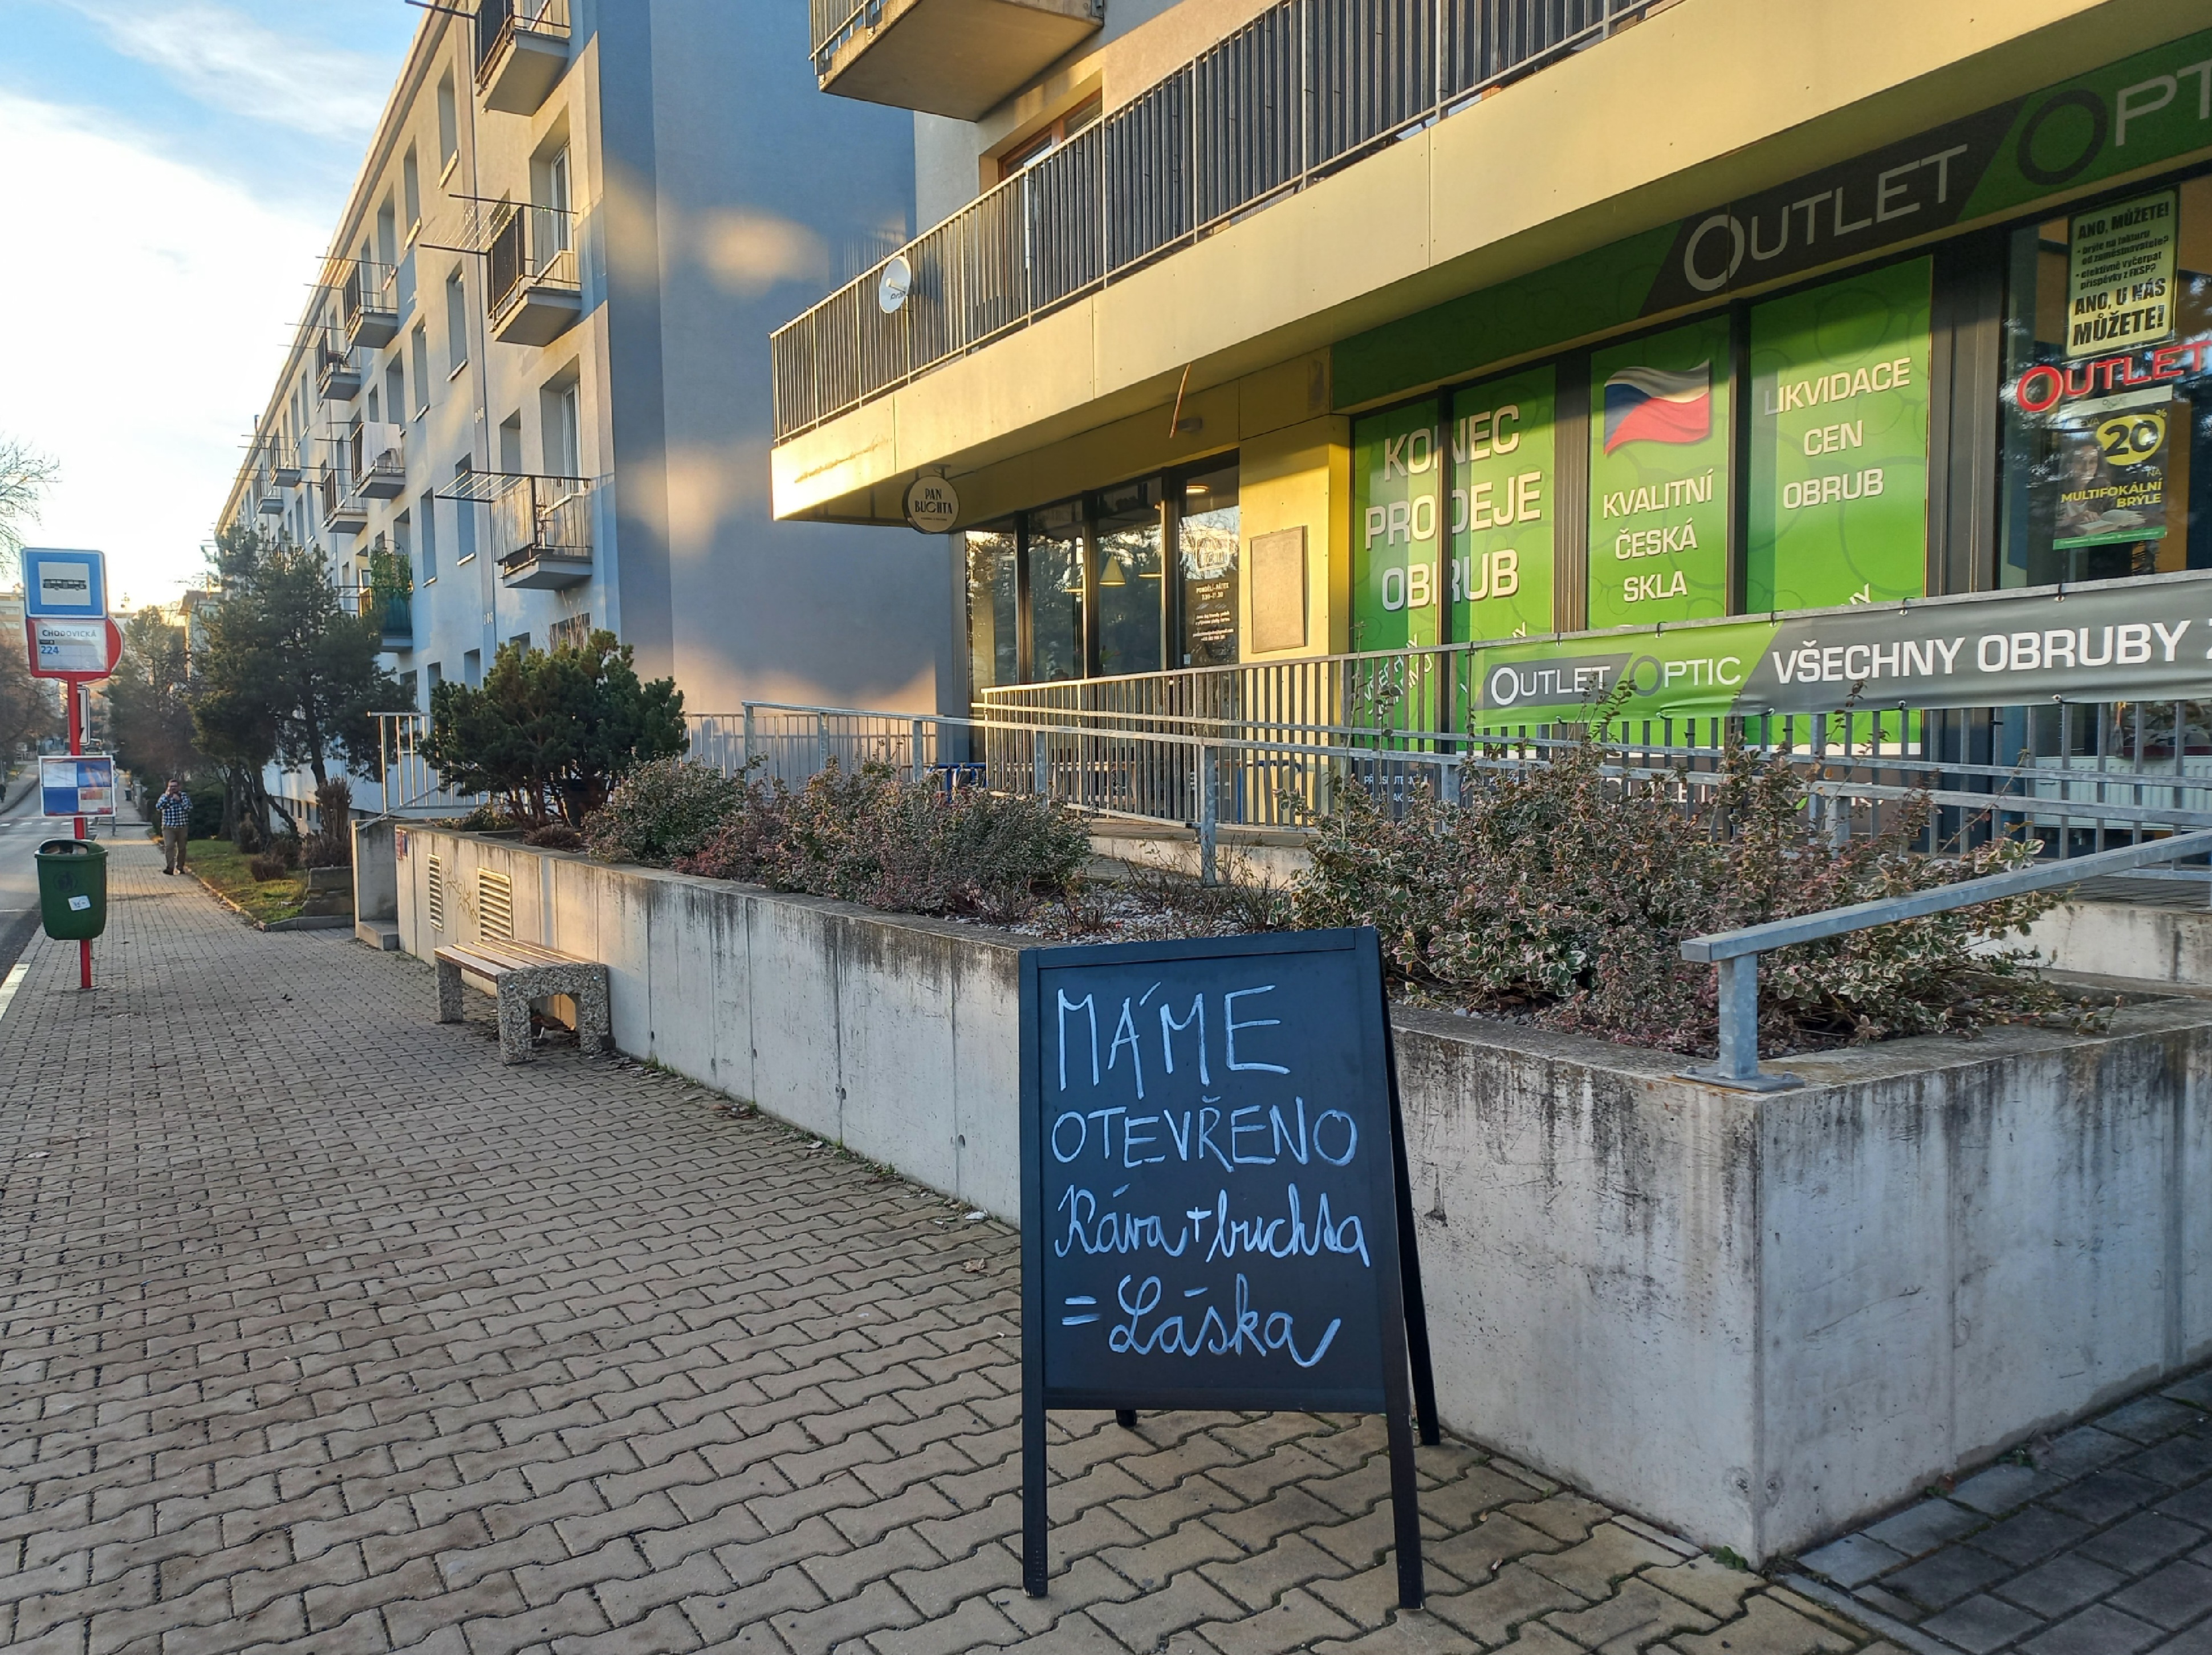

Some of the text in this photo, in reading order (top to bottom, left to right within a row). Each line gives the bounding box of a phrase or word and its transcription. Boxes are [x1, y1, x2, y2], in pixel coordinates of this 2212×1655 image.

[1684, 144, 1968, 292] OUTLET
[2077, 202, 2170, 240] ANO, MŮŽETE!
[2106, 239, 2116, 248] na
[2118, 230, 2150, 245] fakturu
[2080, 273, 2122, 290] příspěvky
[2129, 263, 2156, 277] FKSP?
[2081, 251, 2162, 278] efektivně vyčerpat
[2082, 255, 2092, 265] od
[2075, 278, 2166, 315] ANO, U NÁS
[2073, 304, 2165, 346] MŮŽETE!
[1764, 357, 1911, 416] LIKVIDACE
[2017, 340, 2212, 412] OUTLET
[1384, 404, 1520, 481] KONEC
[1804, 420, 1863, 457] CEN
[2104, 420, 2158, 457] 20
[1783, 468, 1884, 510] OBRUB
[2061, 478, 2163, 503] MULTIFOKÁLNÍ
[2147, 468, 2162, 478] NA
[915, 501, 952, 514] BUCHTA
[925, 488, 942, 499] PAN
[1365, 471, 1542, 550] PRODEJE
[1603, 468, 1714, 519] KVALITNÍ
[2117, 493, 2161, 508] BRÝLE
[1615, 517, 1698, 560] ČESKÁ
[1382, 549, 1519, 611] OBRUB
[1624, 571, 1688, 602] SKLA
[41, 645, 59, 654] 224
[1772, 638, 1966, 685] VŠECHNY
[1978, 620, 2192, 672] OBRUBY
[1491, 655, 1741, 705] OUTLET OPTIC
[1059, 982, 1291, 1100] MÁME
[1051, 1096, 1358, 1173] OTEVŘENO
[1108, 1272, 1341, 1367] Láska
